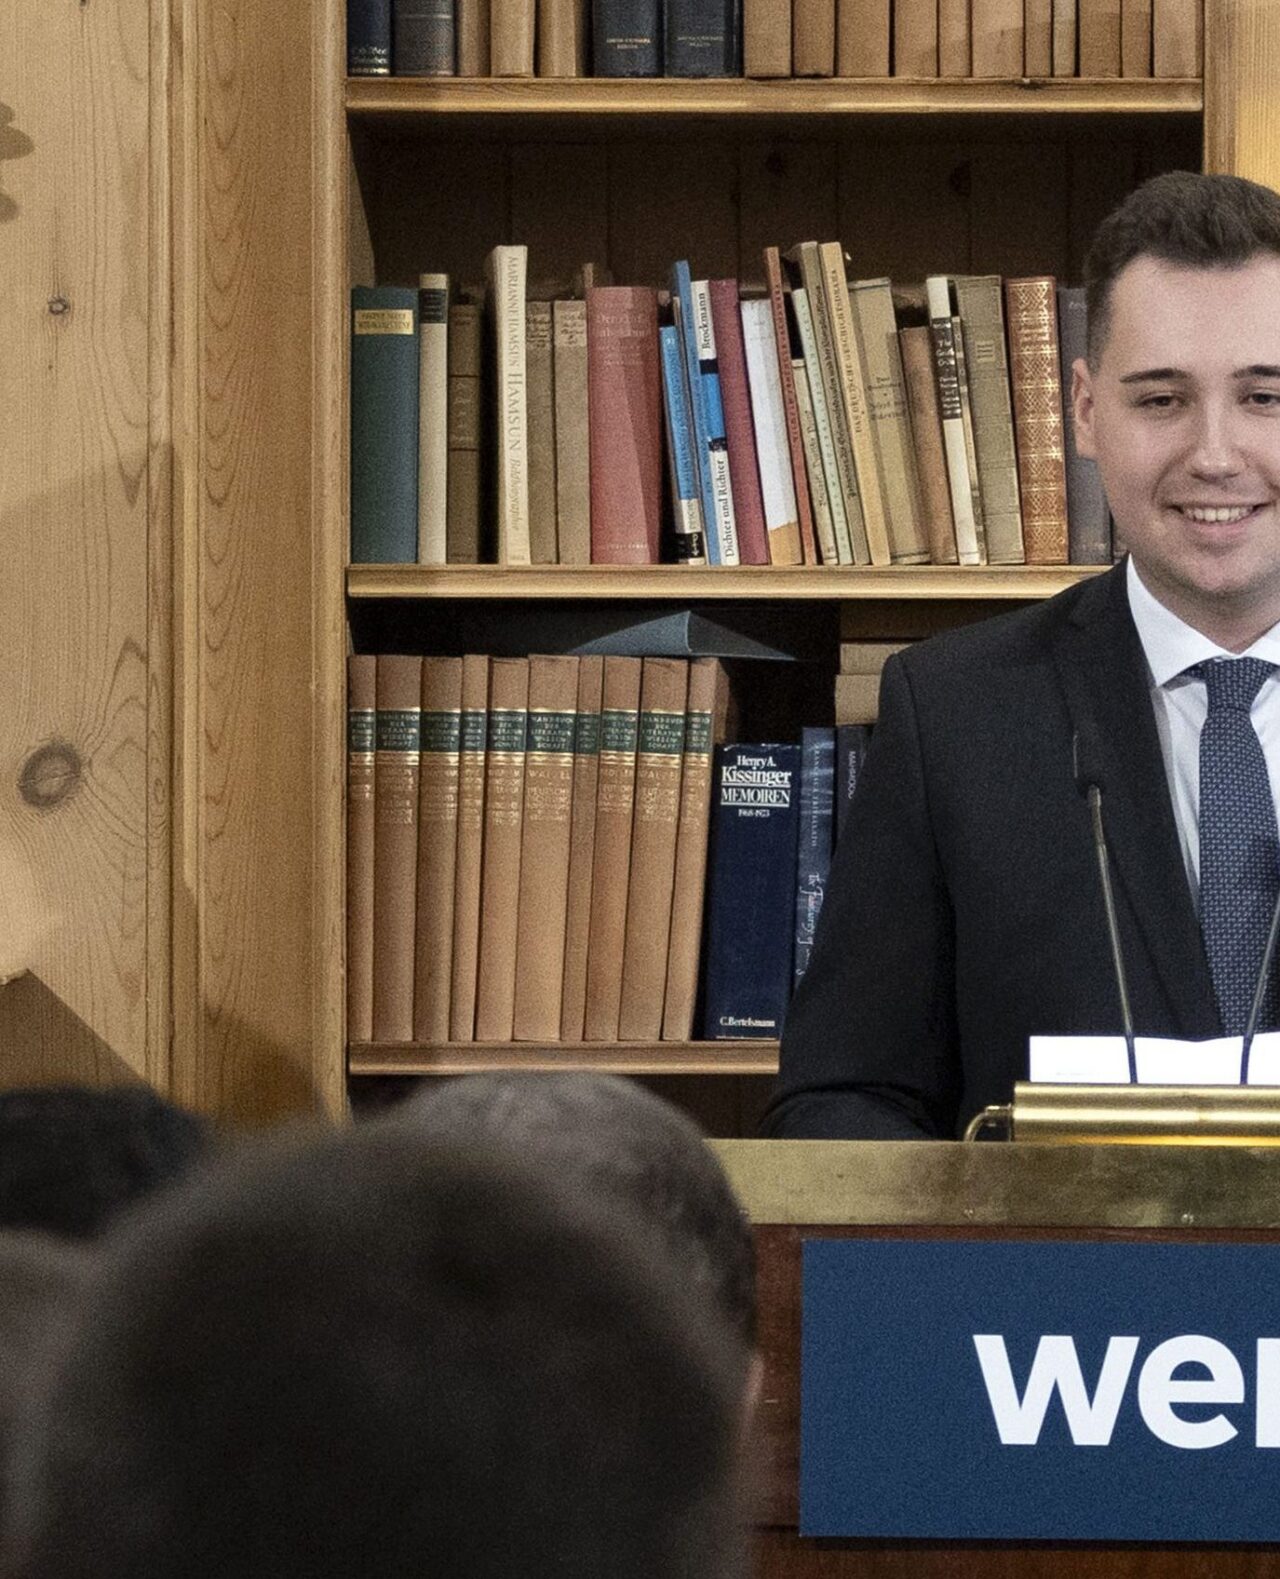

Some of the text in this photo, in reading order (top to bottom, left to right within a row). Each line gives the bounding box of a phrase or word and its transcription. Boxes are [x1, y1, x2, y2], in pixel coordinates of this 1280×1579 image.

[507, 256, 519, 315] MARIANNE
[508, 318, 519, 367] HAMSUN
[697, 292, 712, 349] Brockmann
[507, 373, 523, 450] HAMSUN
[715, 460, 735, 558] Dichter und Richter
[721, 766, 792, 787] Kissinger
[737, 755, 777, 770] Henry A.
[721, 788, 791, 804] MEMOIREN
